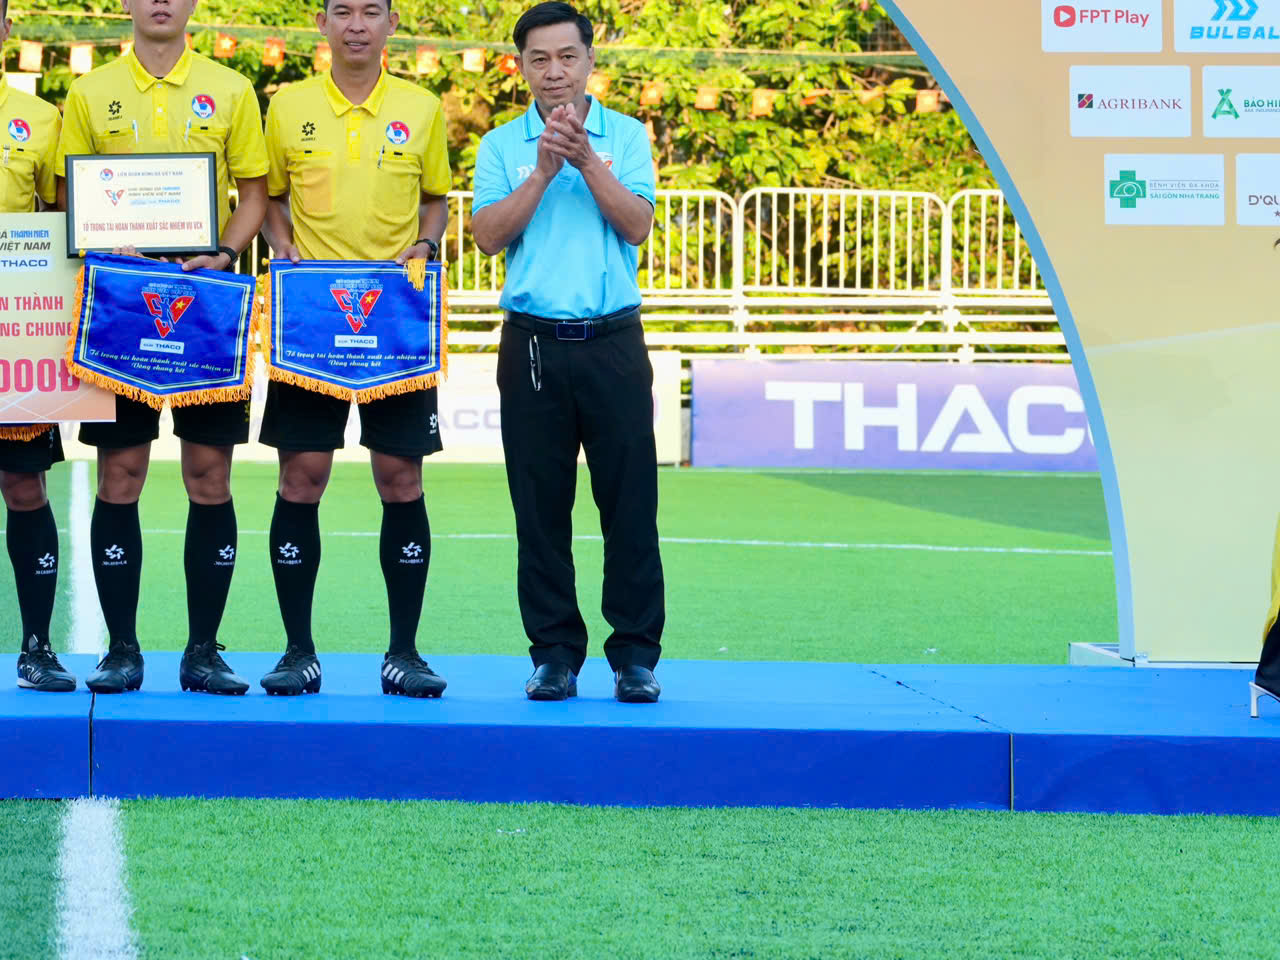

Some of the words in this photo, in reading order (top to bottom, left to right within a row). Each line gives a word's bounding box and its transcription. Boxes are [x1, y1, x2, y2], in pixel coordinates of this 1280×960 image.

[1079, 9, 1111, 24] FPT
[1114, 9, 1150, 28] Play
[1097, 98, 1183, 110] AGRIBANK
[24, 242, 51, 250] NAM
[0, 259, 48, 267] THACO
[14, 292, 64, 311] THÀNH
[765, 381, 1095, 454] THAC
